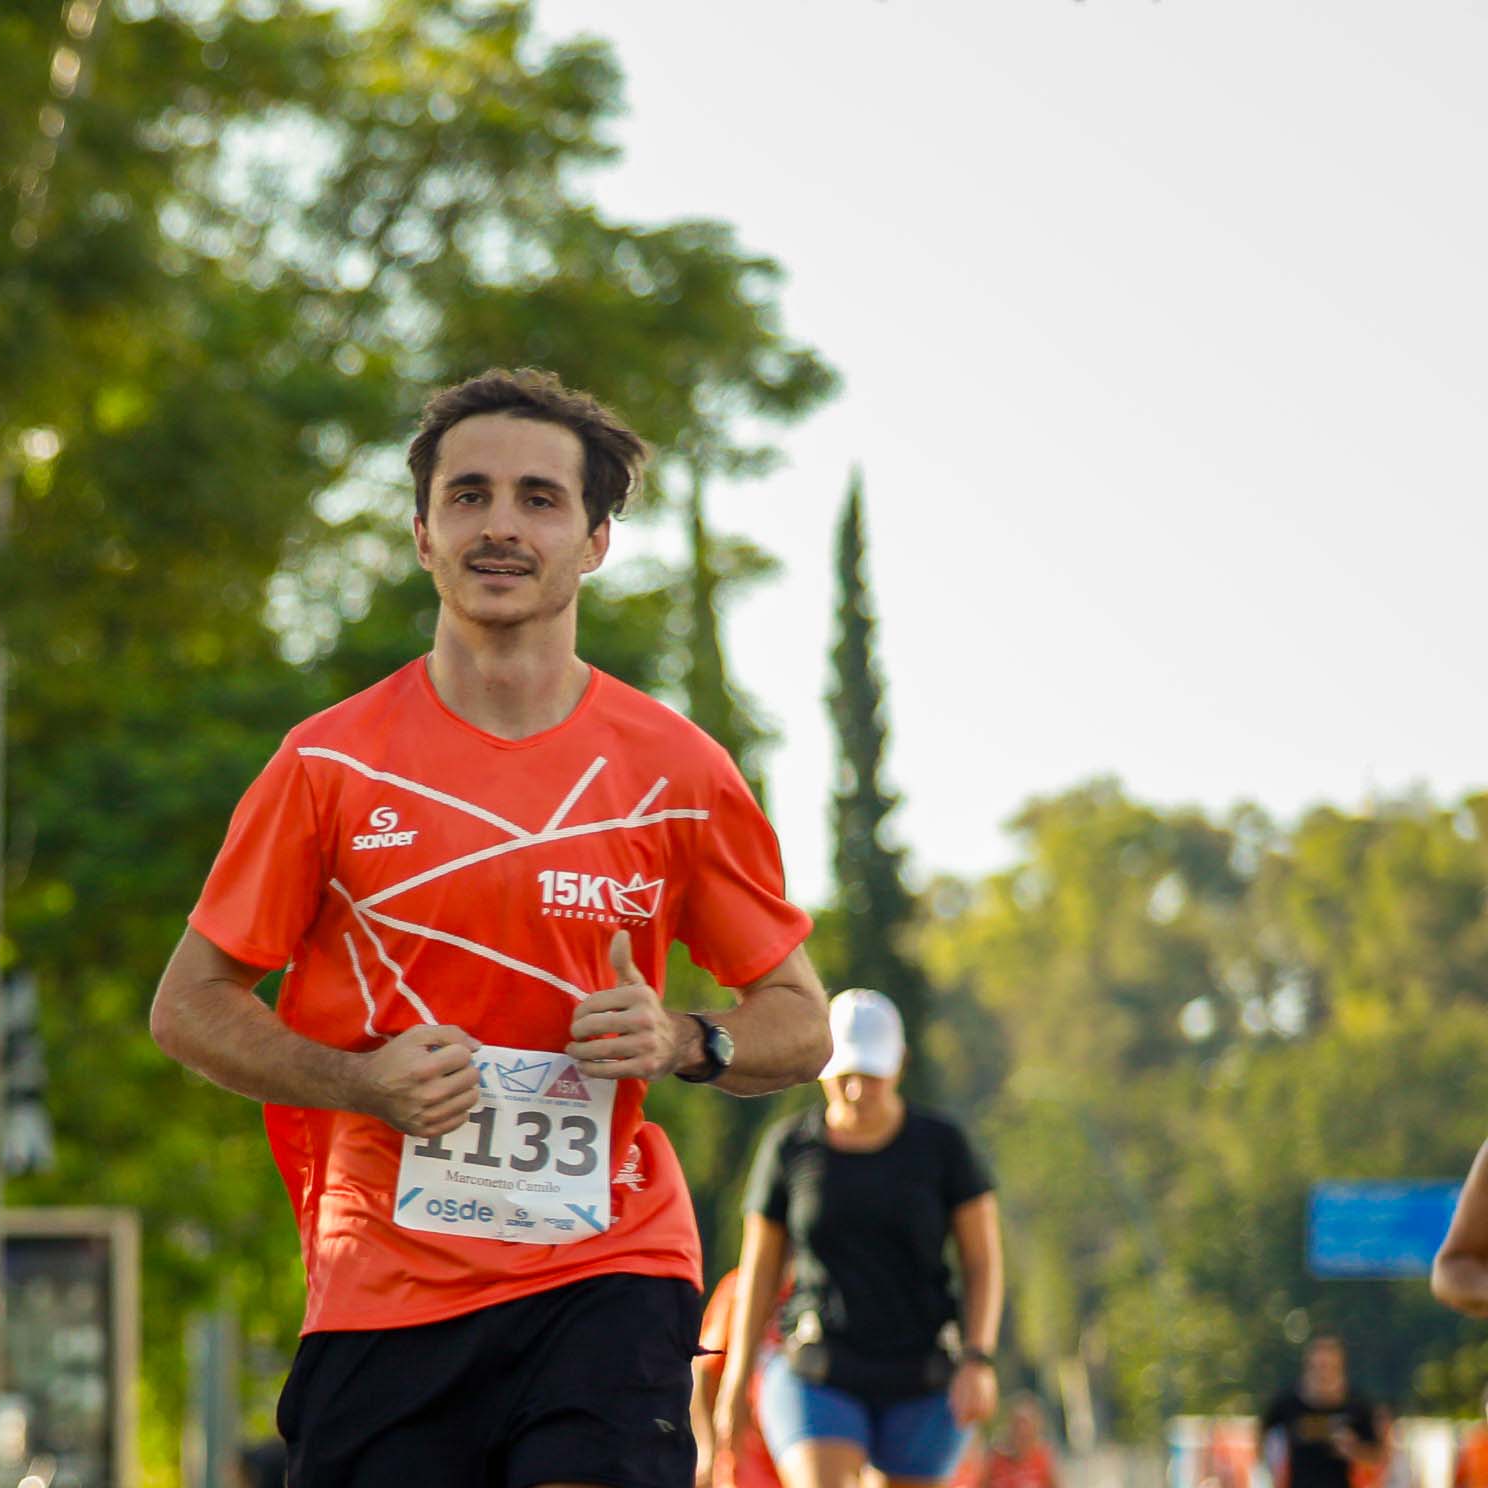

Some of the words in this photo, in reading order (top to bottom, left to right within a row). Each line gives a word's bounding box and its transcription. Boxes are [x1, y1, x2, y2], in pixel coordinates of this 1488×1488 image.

[537, 870, 608, 909] 15K
[541, 907, 605, 922] PUERTO
[445, 1169, 514, 1190] Marconetto
[517, 1179, 561, 1193] Camilo
[426, 1198, 494, 1223] osde
